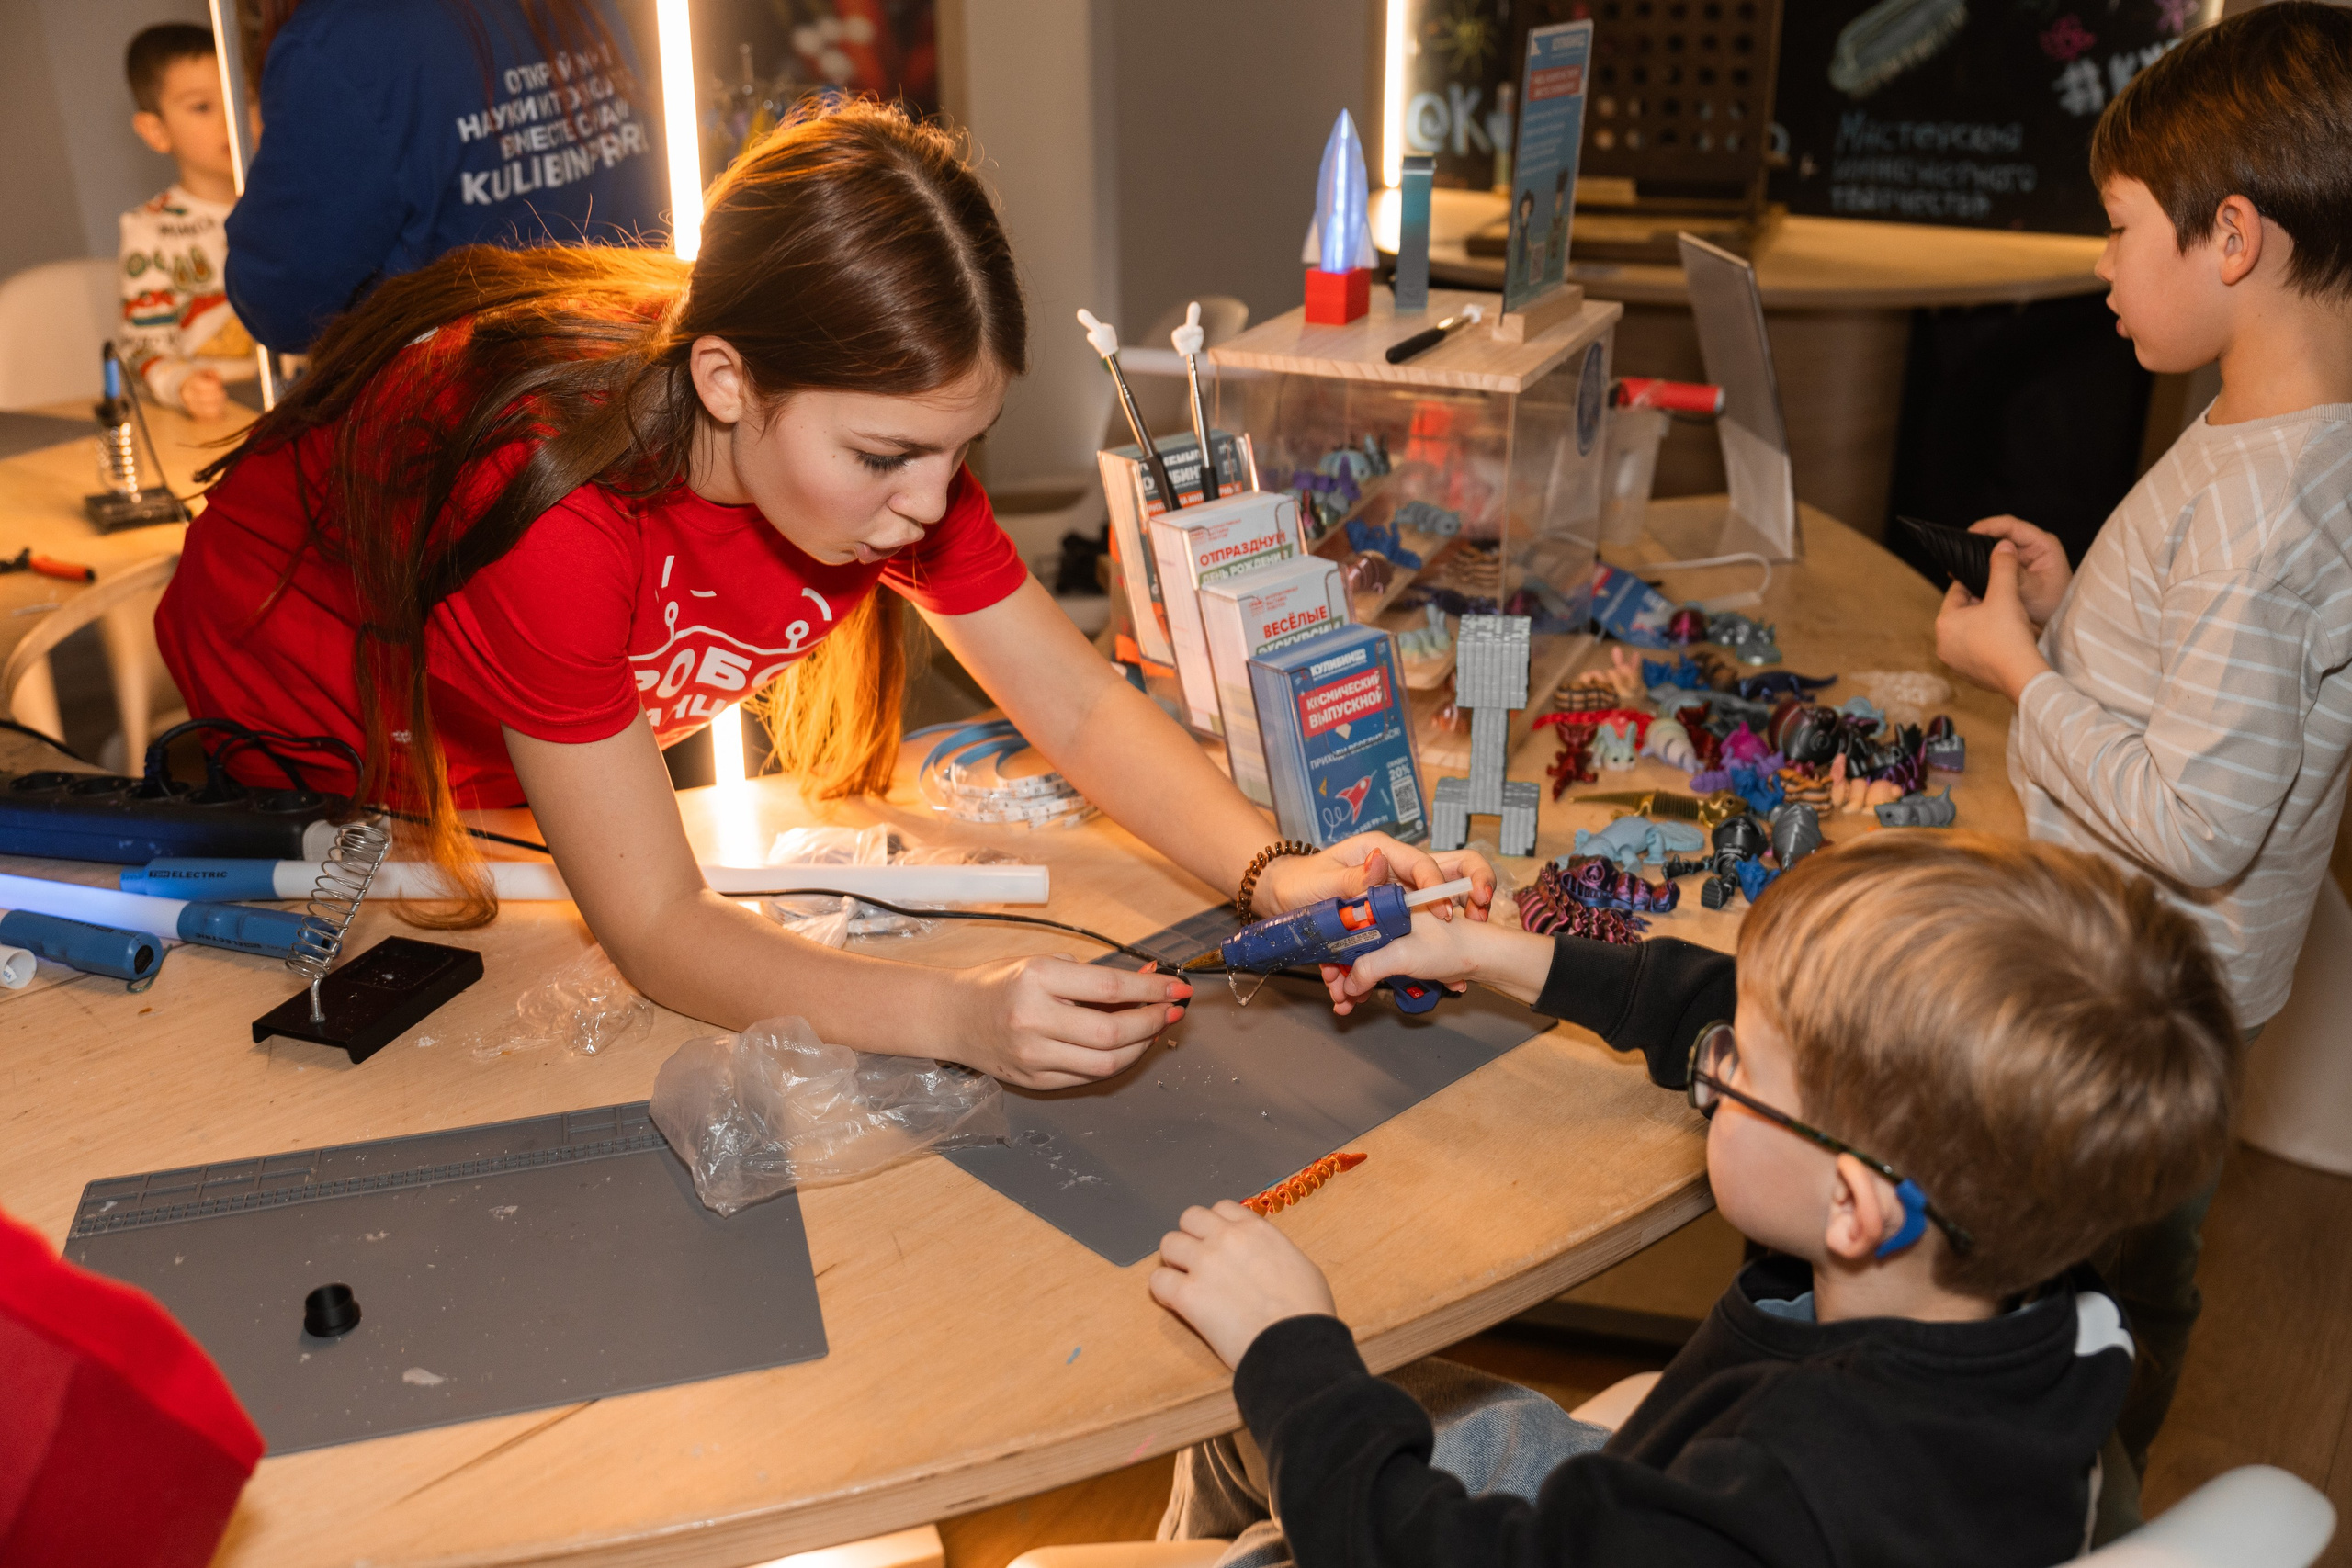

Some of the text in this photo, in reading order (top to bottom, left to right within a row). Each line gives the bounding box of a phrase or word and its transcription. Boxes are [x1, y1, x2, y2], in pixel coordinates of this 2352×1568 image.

[503, 51, 572, 96] ОТКРЙ
[1200, 531, 1287, 567] ОТПРАЗДНУЙ
[1262, 605, 1328, 639] ВЕСЁЛЫЕ
[1306, 671, 1381, 710] КОСМИЧЕСКИЙ
[1308, 686, 1387, 729] ВЫПУСКНОЙ
[1388, 762, 1412, 781] 20%
[171, 870, 229, 879] ELECTRIC
